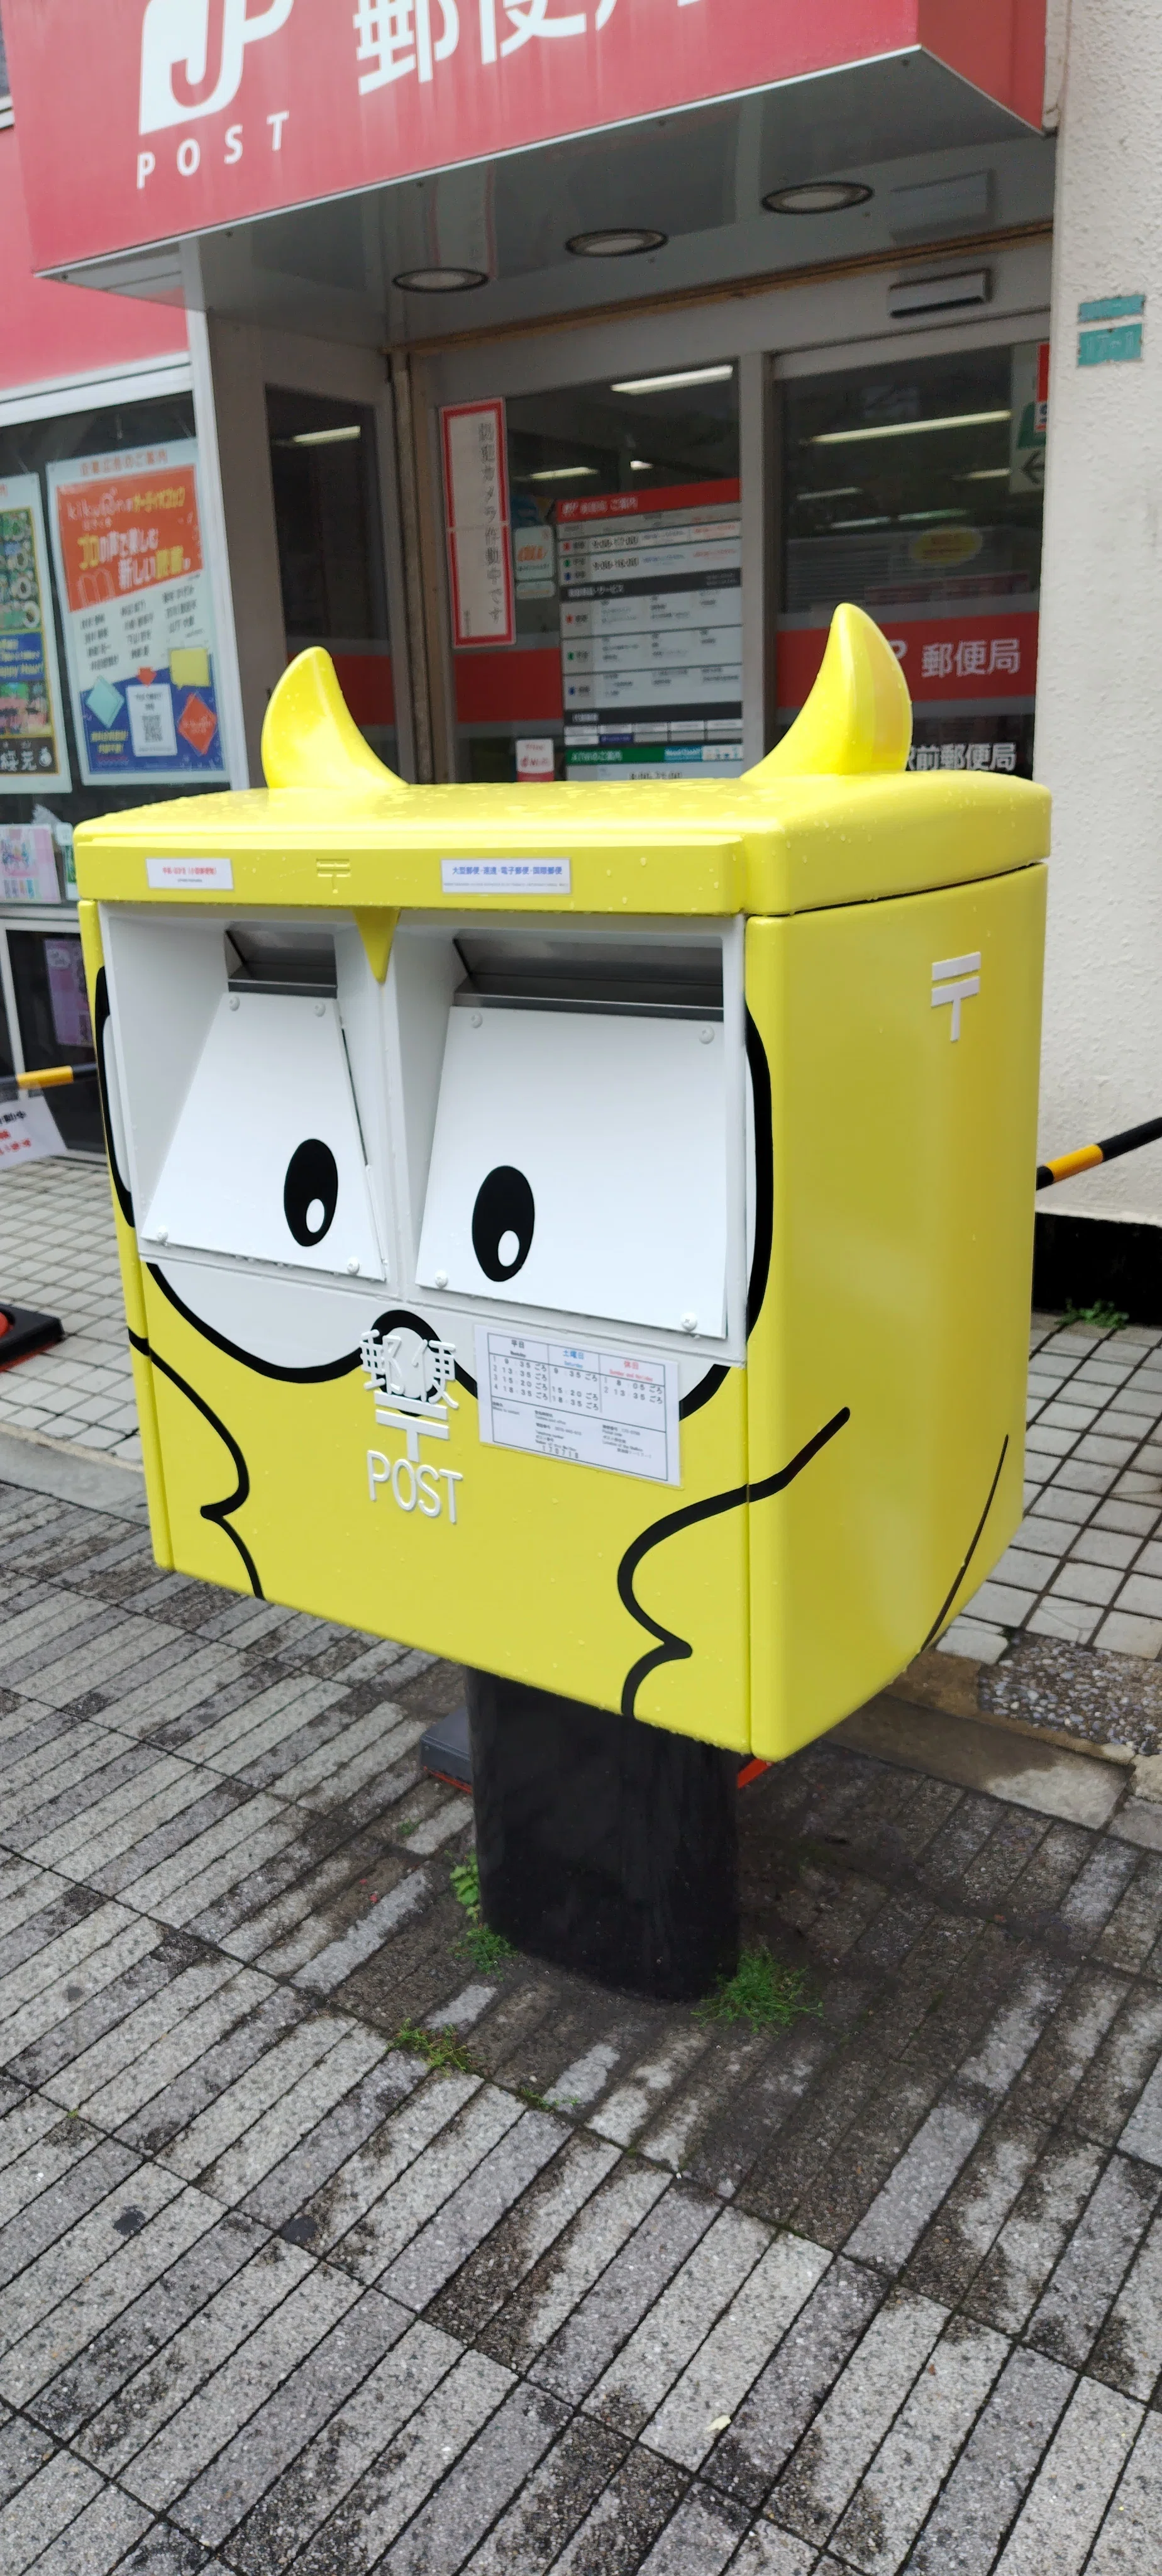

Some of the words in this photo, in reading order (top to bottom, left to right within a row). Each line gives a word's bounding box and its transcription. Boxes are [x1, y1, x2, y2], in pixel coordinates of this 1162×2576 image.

[136, 110, 290, 189] POST
[921, 637, 1022, 679] 郵便局
[511, 1340, 524, 1348] 平日
[563, 1350, 584, 1359] 土曜日
[359, 1329, 459, 1411] 郵便
[624, 1361, 639, 1370] 休日
[367, 1449, 463, 1524] POST
